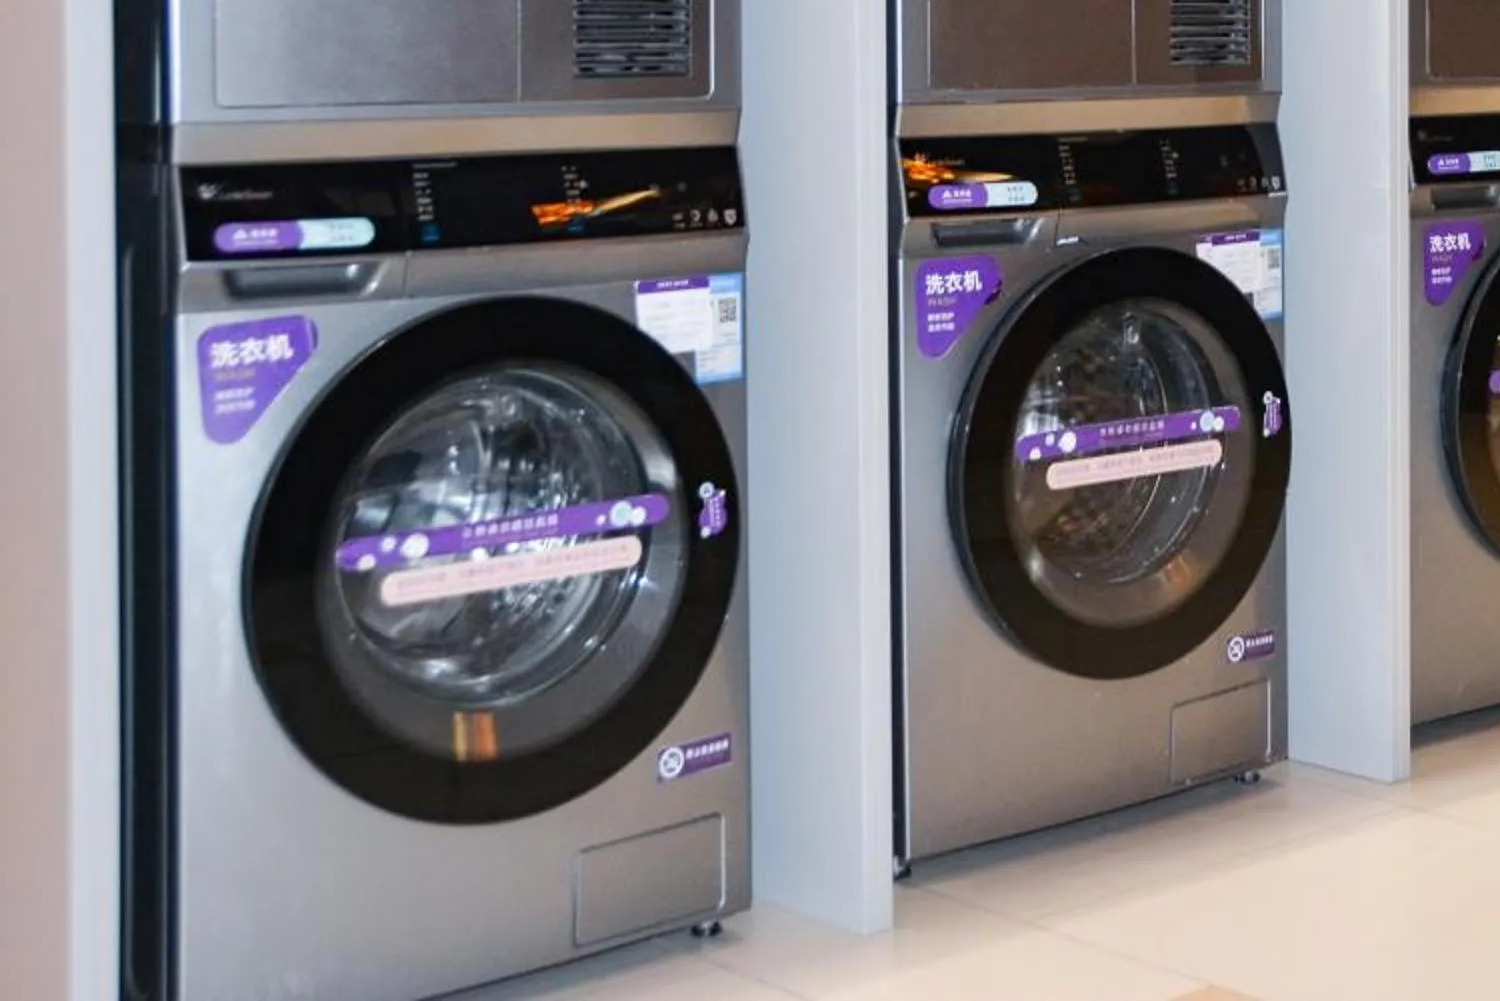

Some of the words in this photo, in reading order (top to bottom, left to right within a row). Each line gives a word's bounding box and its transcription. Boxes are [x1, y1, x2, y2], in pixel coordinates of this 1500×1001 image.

[1429, 231, 1471, 253] 洗衣机
[925, 269, 983, 295] 洗衣机
[210, 334, 295, 368] 洗衣机
